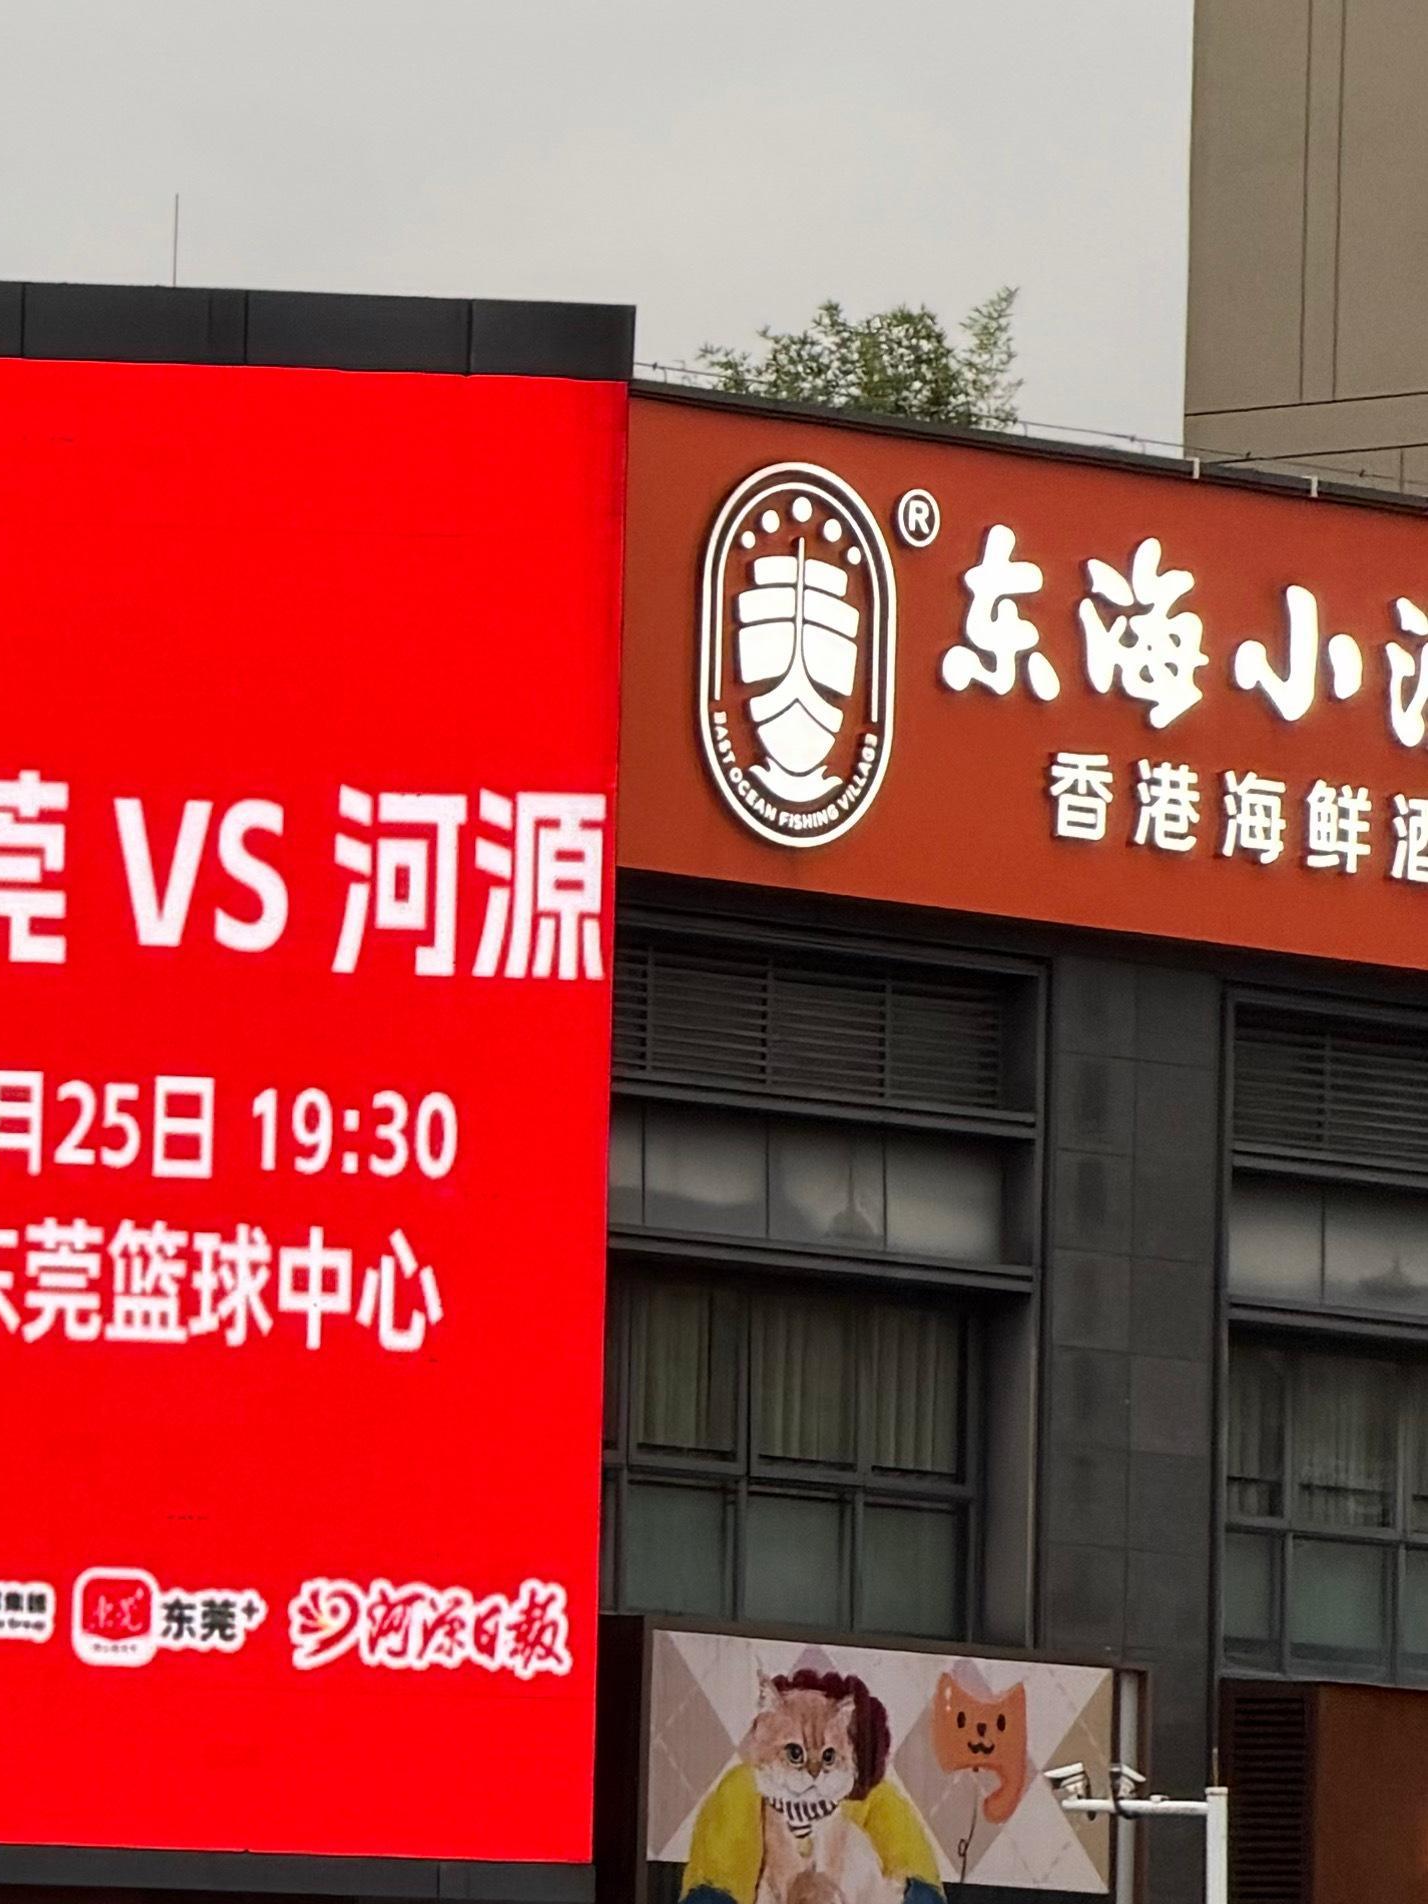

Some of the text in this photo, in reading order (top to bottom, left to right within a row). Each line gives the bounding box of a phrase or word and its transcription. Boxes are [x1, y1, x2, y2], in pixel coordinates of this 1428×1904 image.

[713, 711, 879, 831] EAST OCEAN FISHING VILLAGE
[113, 797, 290, 953] VS
[331, 784, 607, 981] 河源
[251, 1088, 459, 1180] 19:30
